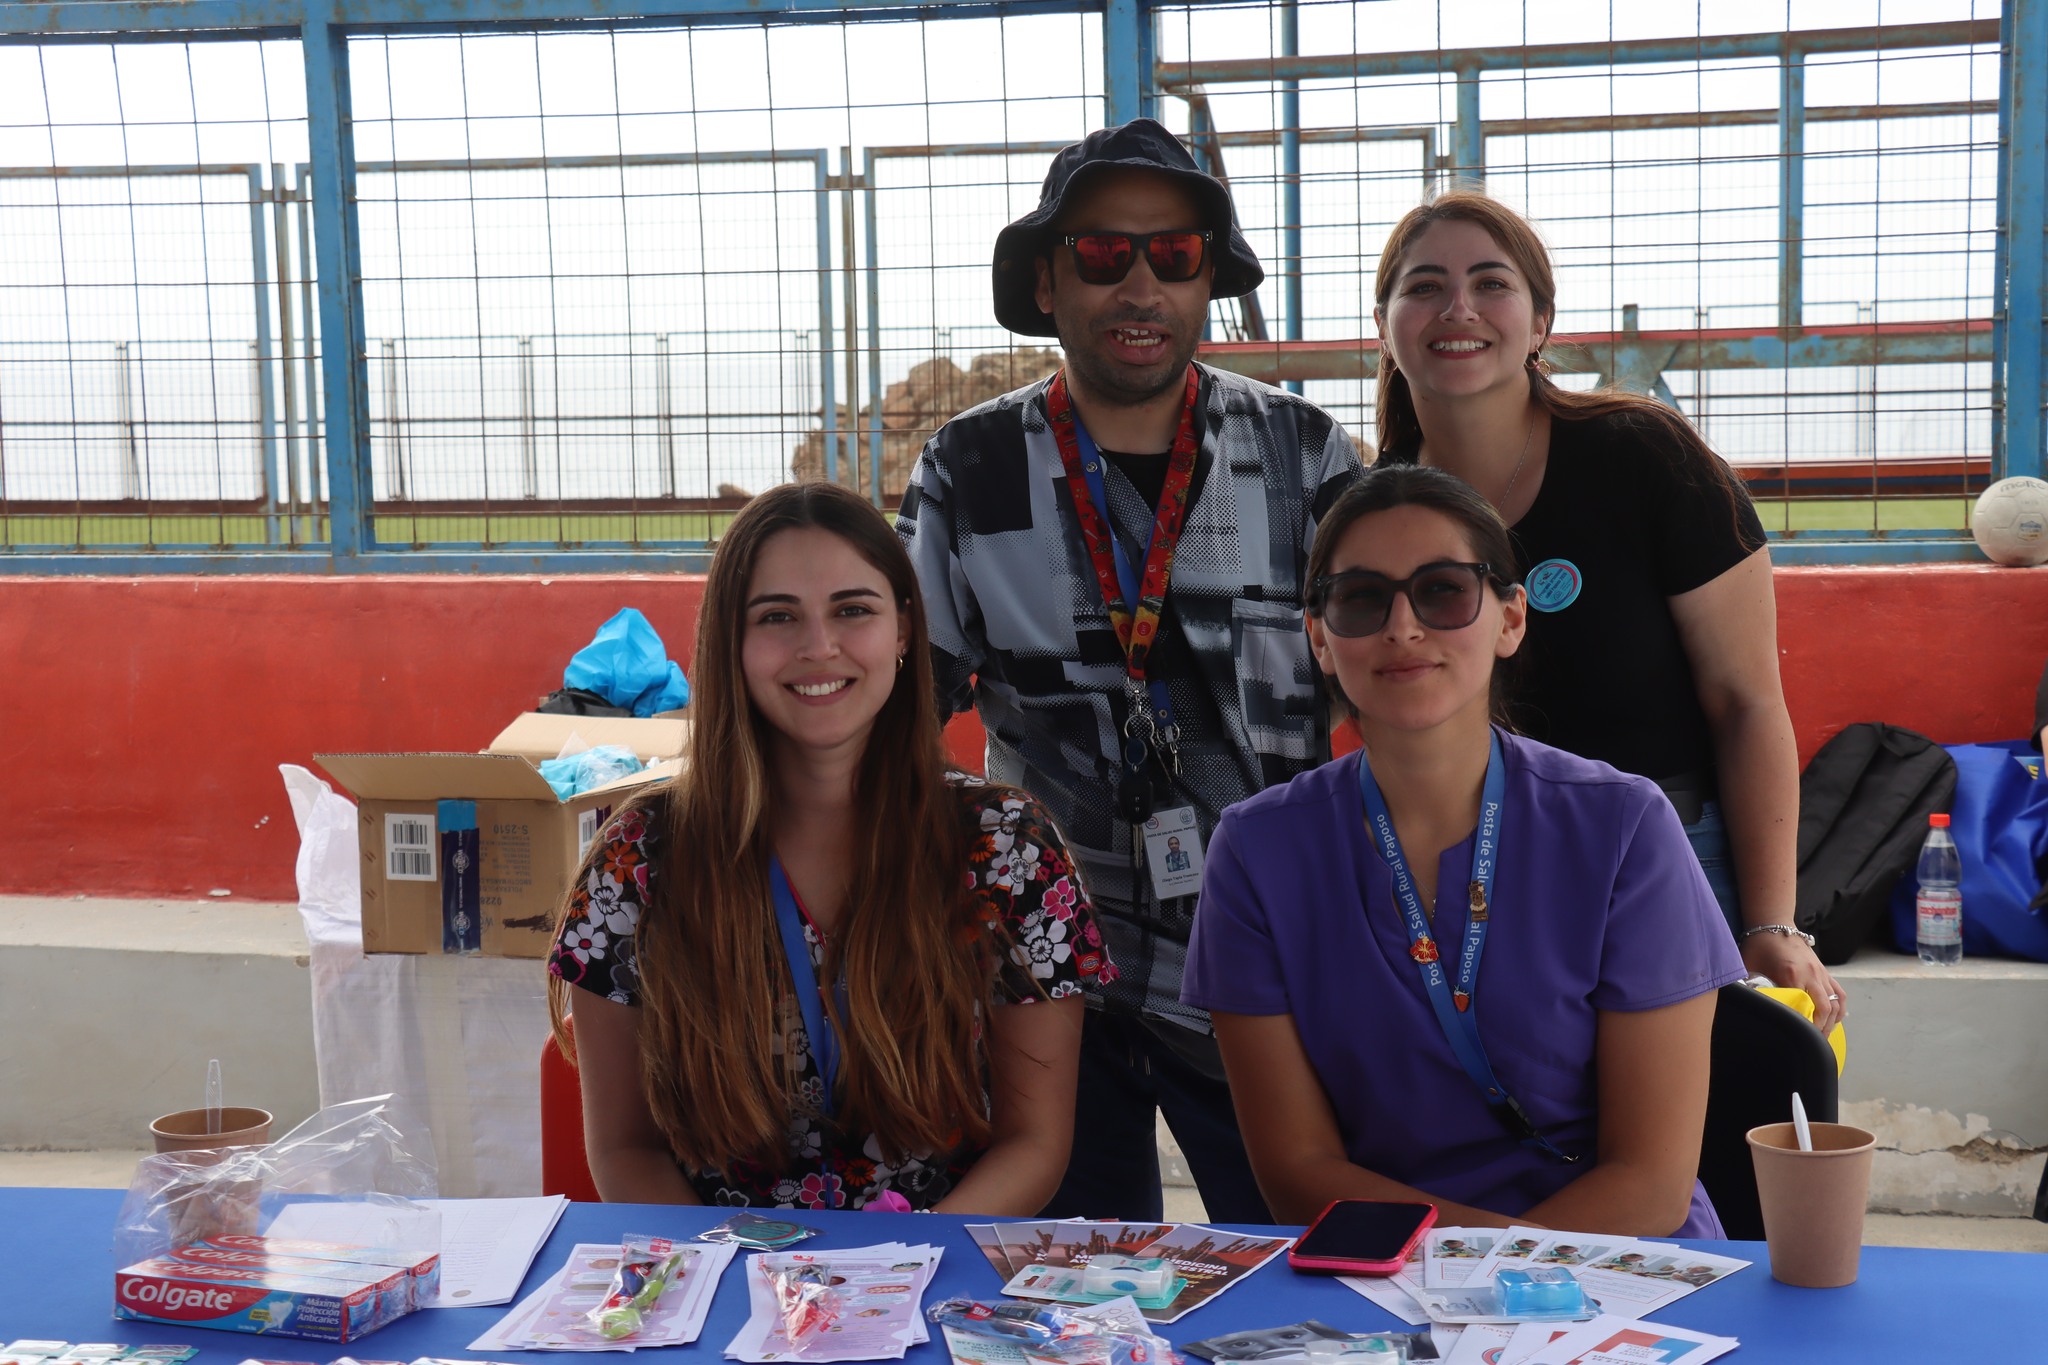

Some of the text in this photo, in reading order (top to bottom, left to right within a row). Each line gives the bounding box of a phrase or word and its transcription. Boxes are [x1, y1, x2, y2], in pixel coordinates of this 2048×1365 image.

[1483, 802, 1498, 837] Posta
[1376, 814, 1398, 858] Paposo
[1481, 839, 1493, 856] de
[1391, 858, 1410, 892] Rural
[1402, 891, 1423, 930] Salud
[1462, 937, 1480, 983] Paposo
[1429, 963, 1442, 986] Pos
[1165, 1257, 1228, 1271] MEDICINA
[122, 1277, 233, 1311] Colgate
[306, 1297, 340, 1309] Máxima
[297, 1305, 340, 1317] Protección
[297, 1313, 339, 1325] Anticaries
